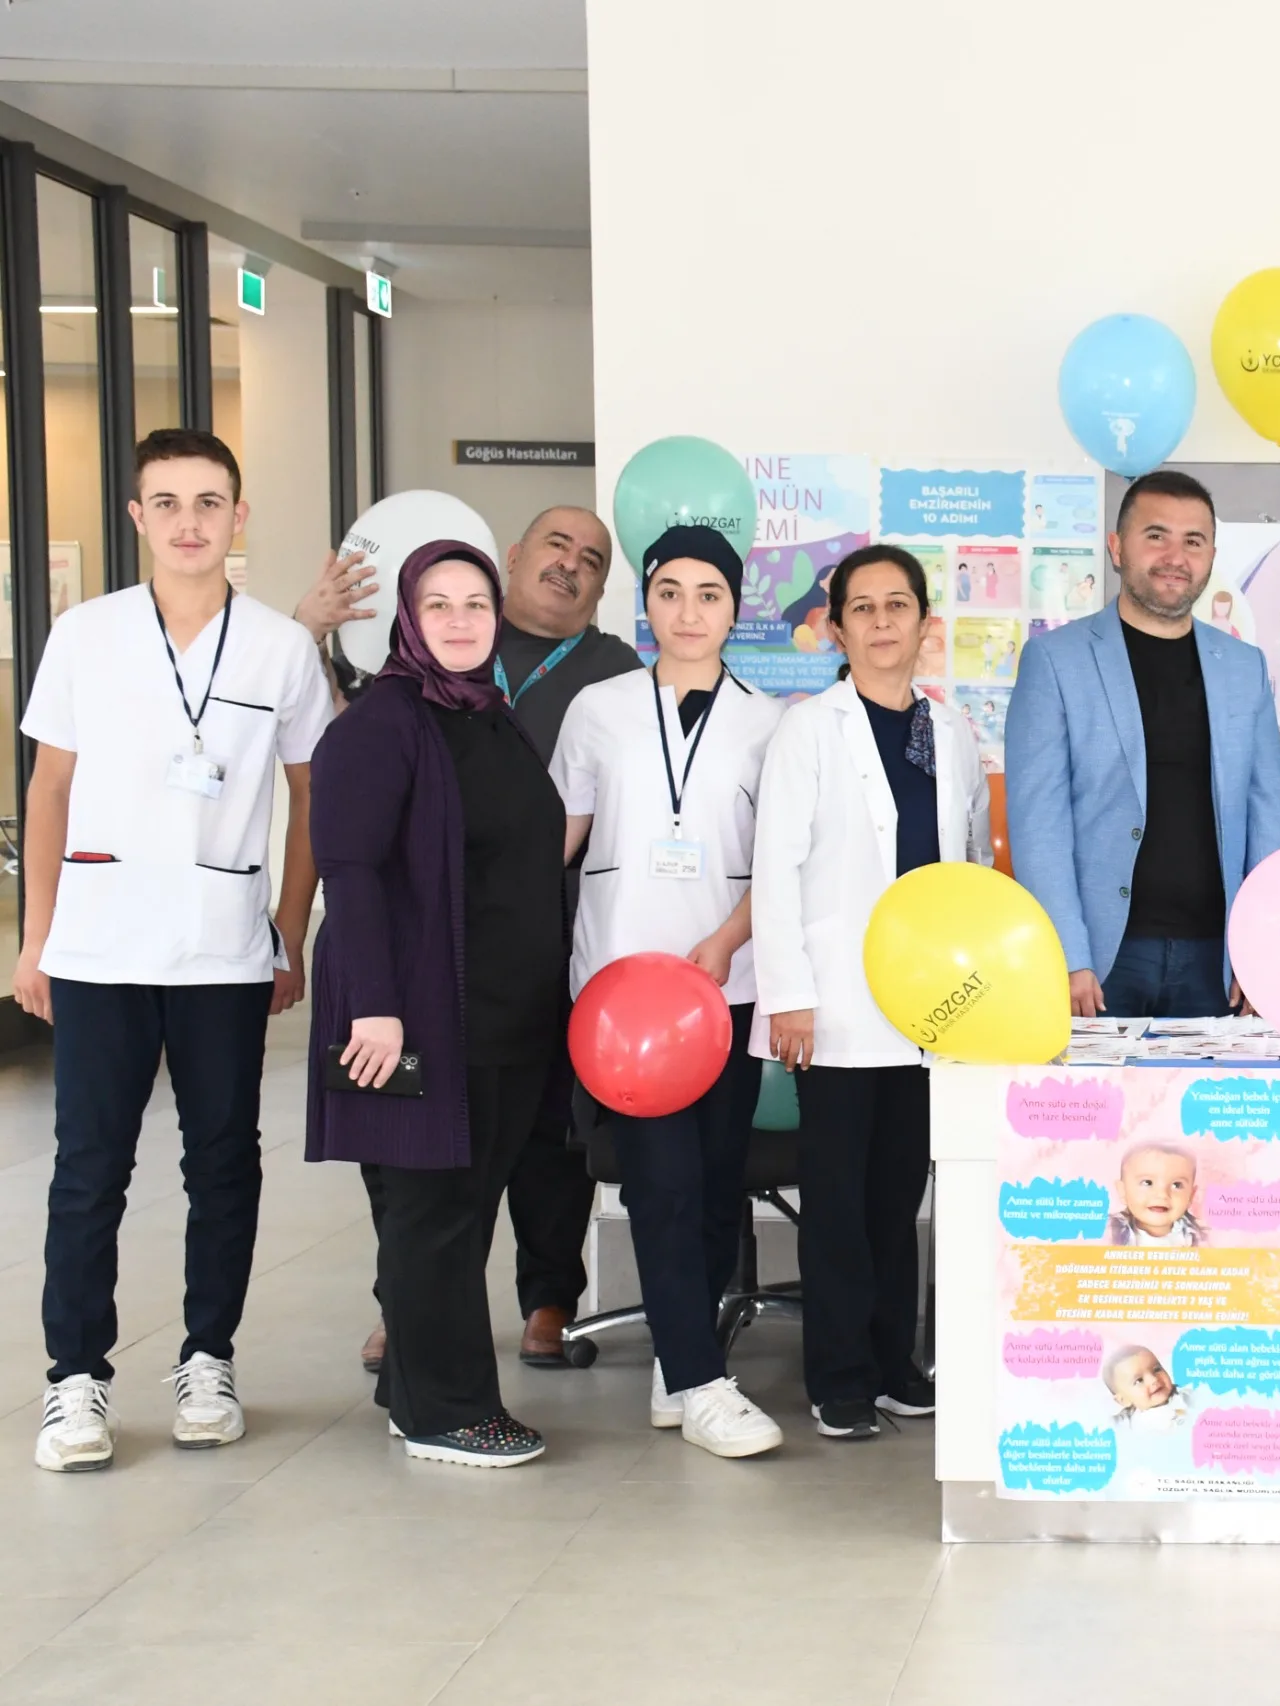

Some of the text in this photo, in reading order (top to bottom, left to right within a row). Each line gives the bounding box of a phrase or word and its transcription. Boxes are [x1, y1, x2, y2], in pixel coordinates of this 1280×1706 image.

[466, 446, 578, 462] Göğüs Hastalıkları
[921, 485, 979, 499] BAŞARILI
[909, 497, 992, 511] EMZİRMENİN
[690, 516, 742, 529] YOZGAT
[923, 513, 978, 524] 10 ADIMI
[923, 970, 984, 1028] YOZGAT
[1191, 1089, 1241, 1103] Yenidoğan
[1242, 1090, 1270, 1102] bebek
[1208, 1104, 1271, 1115] en ideal besin
[1210, 1119, 1233, 1128] anne
[1006, 1196, 1105, 1208] Anne sütü her zaman
[1003, 1209, 1029, 1220] temiz
[1030, 1211, 1042, 1220] ve
[1179, 1342, 1207, 1353] Anne
[1208, 1342, 1228, 1353] sütü
[1229, 1342, 1249, 1353] alan
[1003, 1437, 1112, 1448] Anne sütü alan bebekler
